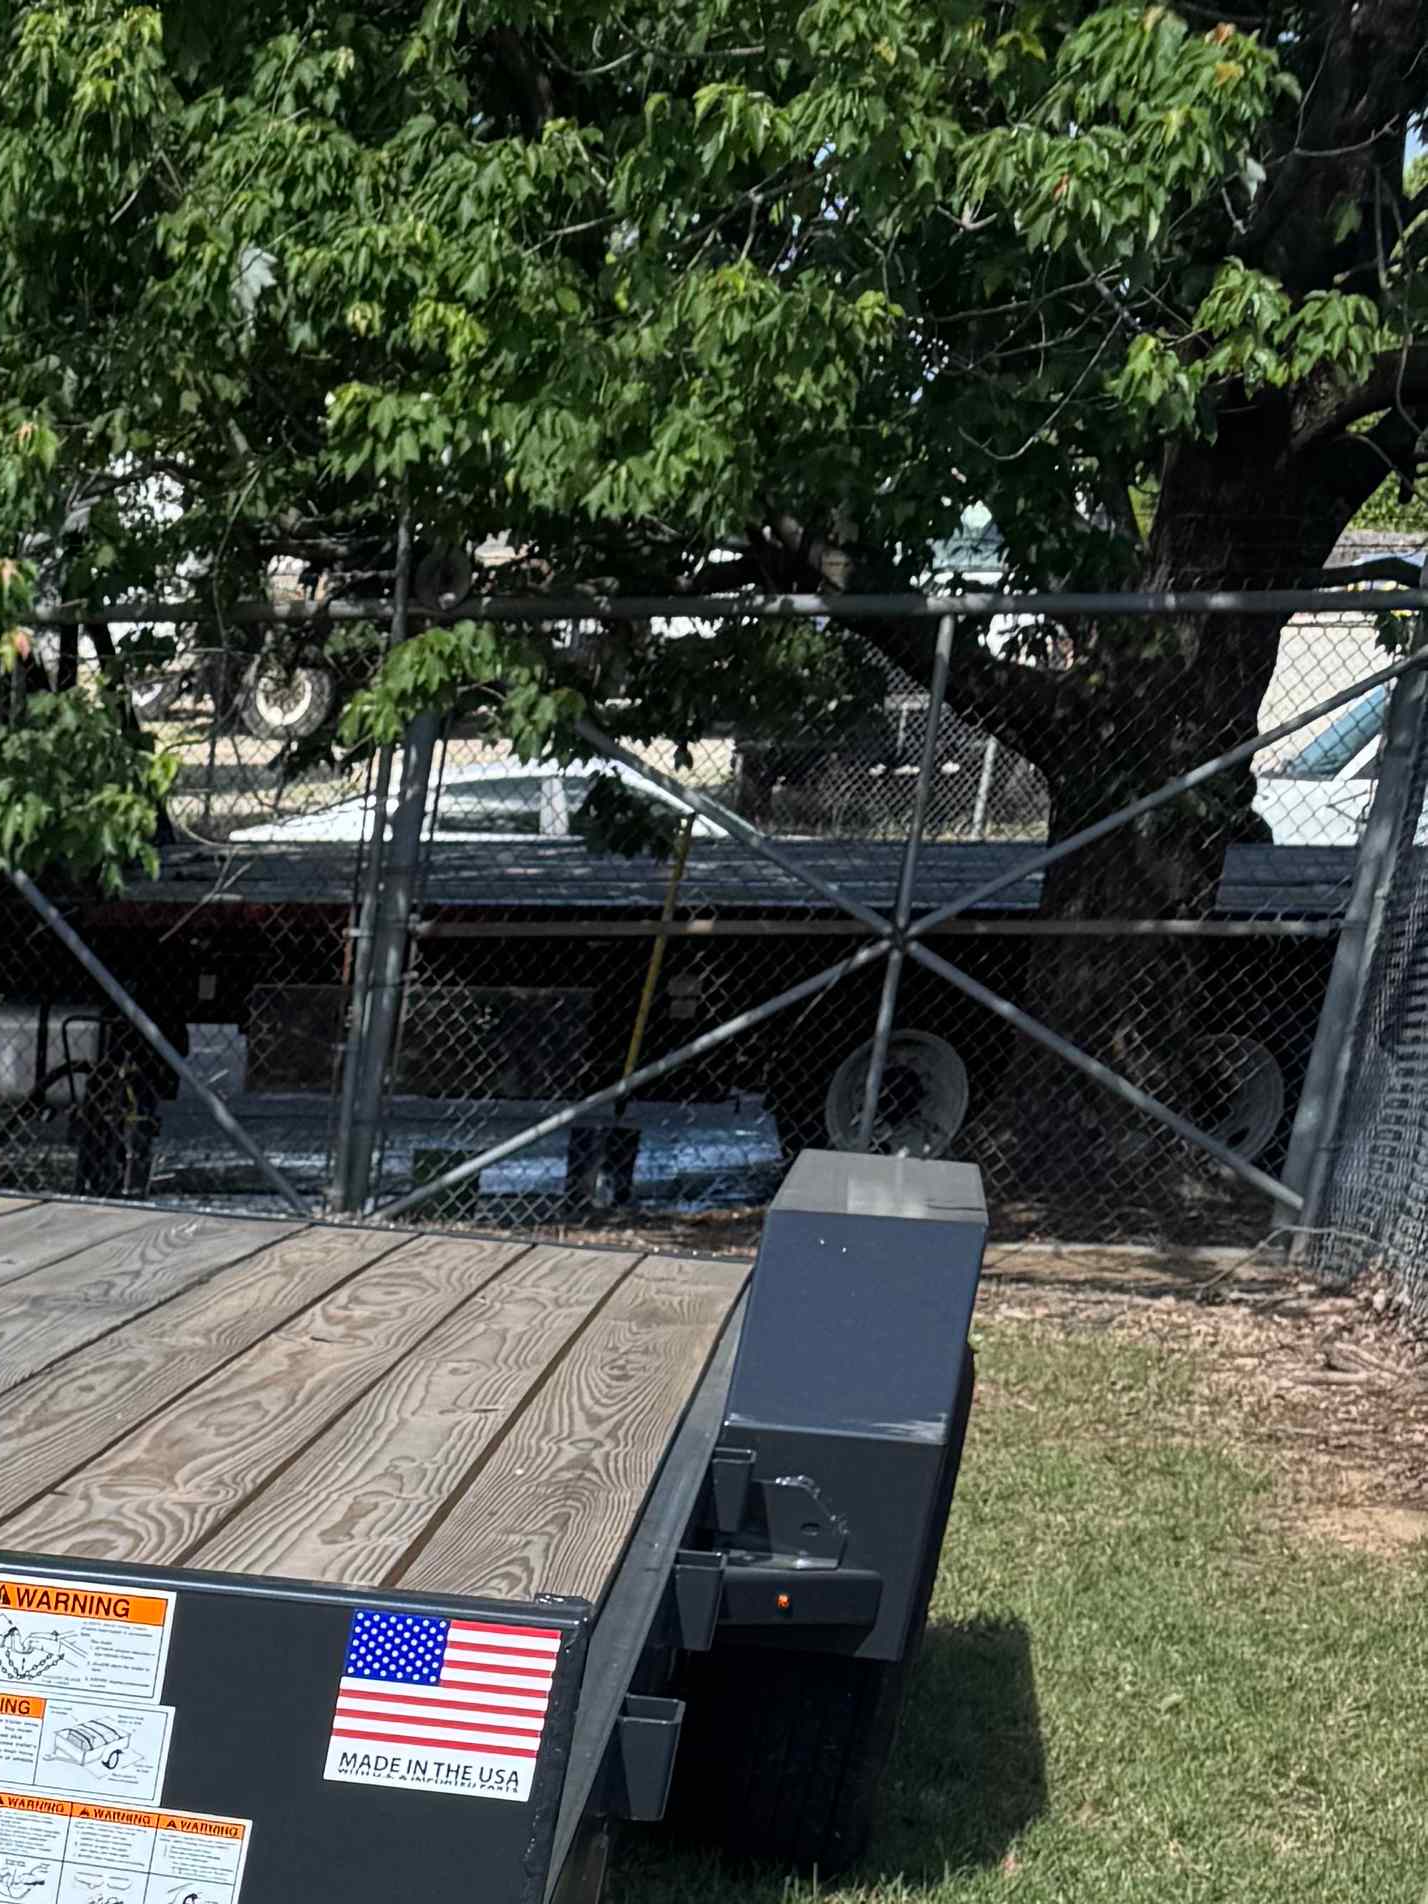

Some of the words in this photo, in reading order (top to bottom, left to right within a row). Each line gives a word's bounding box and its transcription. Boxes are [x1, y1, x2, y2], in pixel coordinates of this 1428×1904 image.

[16, 1587, 131, 1618] WARNING
[339, 1752, 402, 1773] MADE
[406, 1759, 428, 1775] IN
[433, 1761, 473, 1781] THE
[479, 1766, 520, 1787] USA
[8, 1796, 65, 1813] WARNING
[94, 1809, 151, 1826] WARNING
[180, 1821, 238, 1837] WARNING
